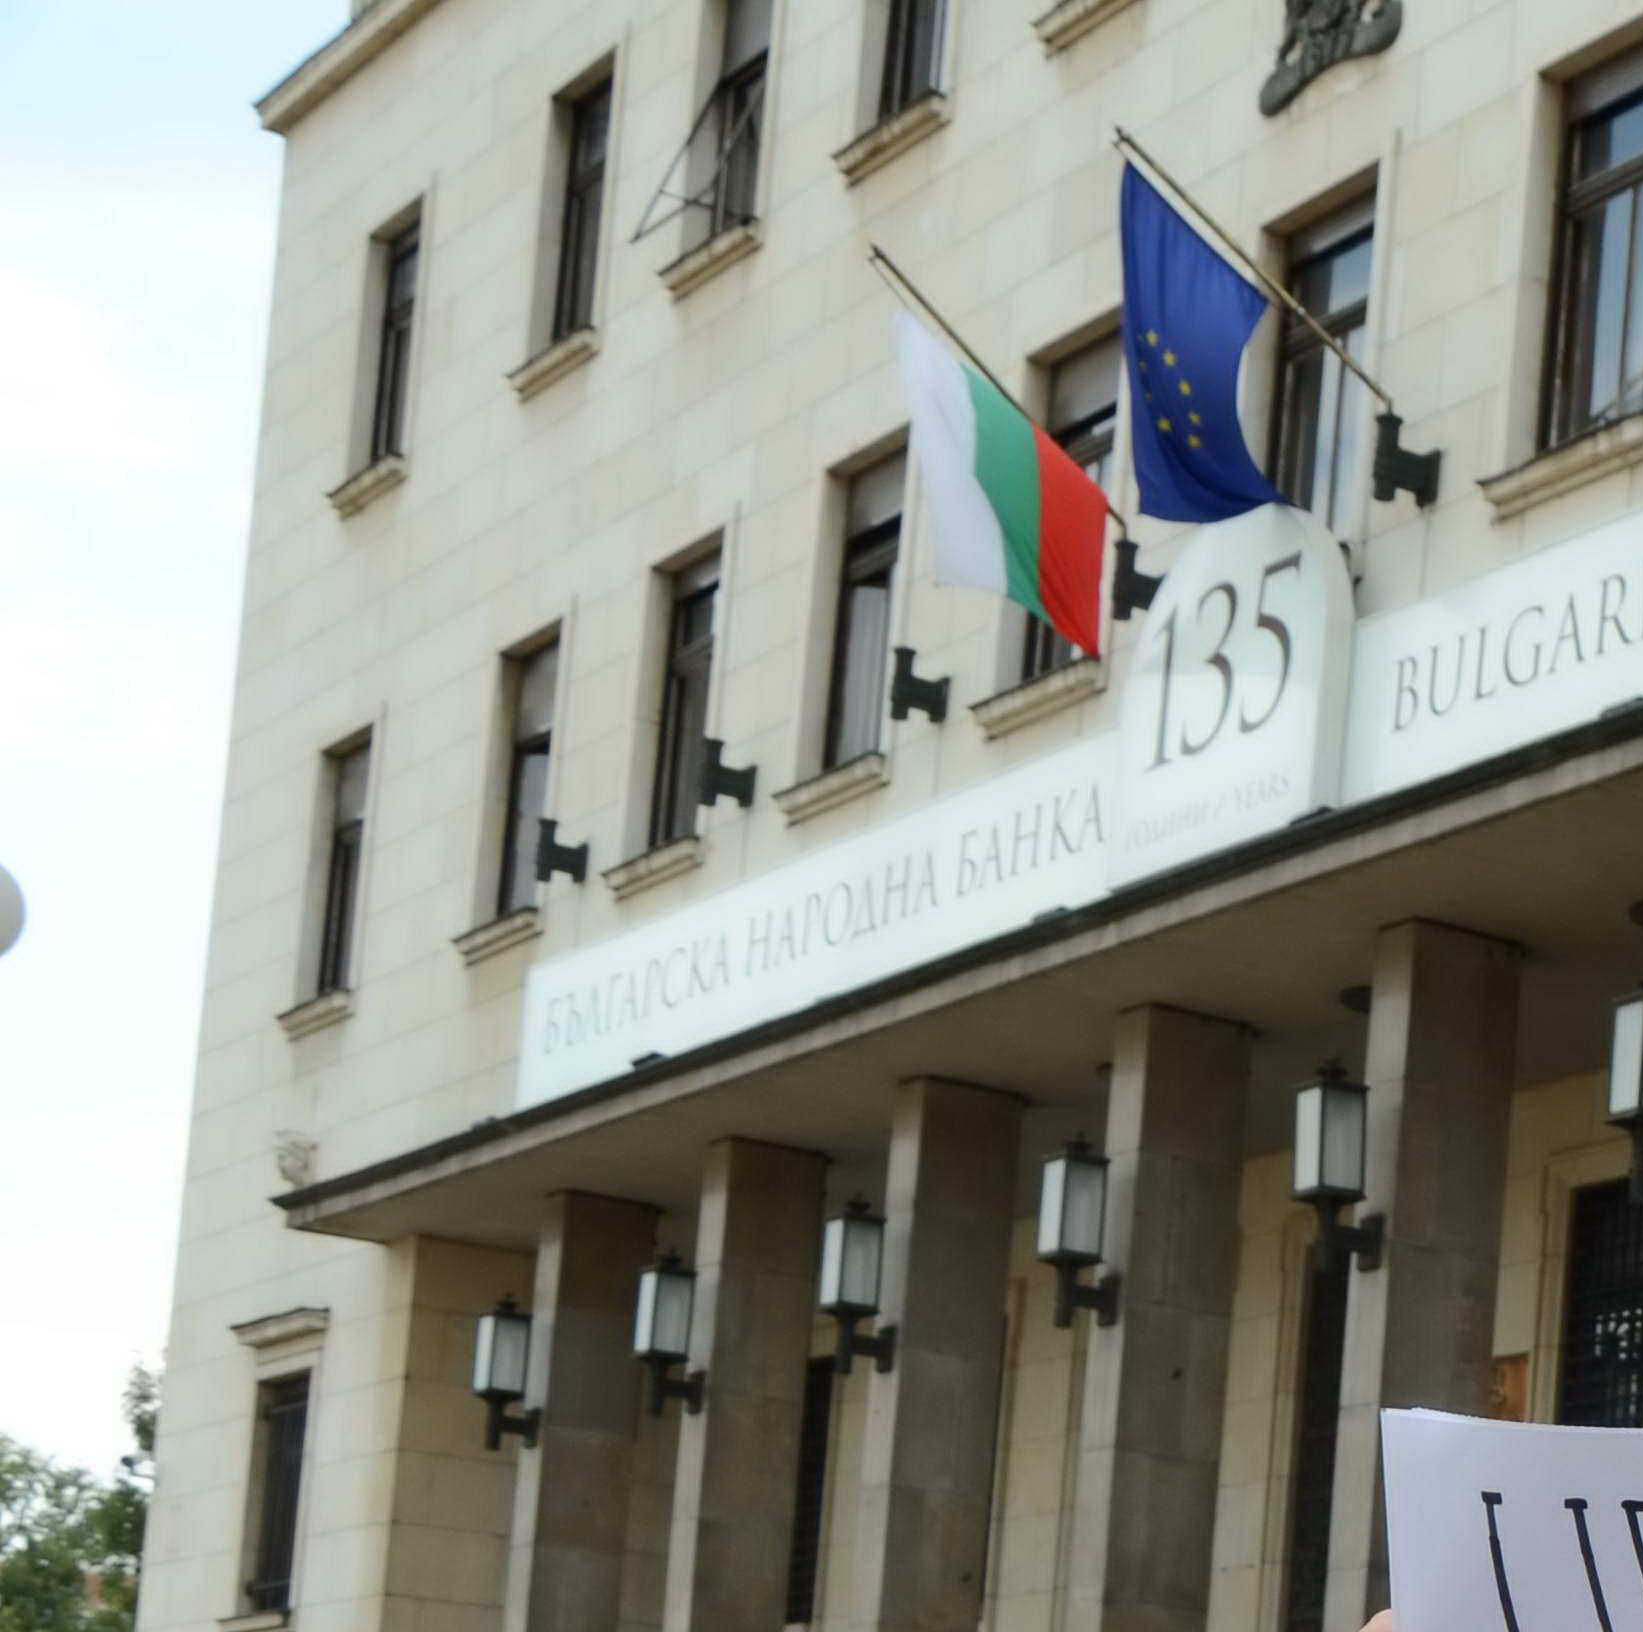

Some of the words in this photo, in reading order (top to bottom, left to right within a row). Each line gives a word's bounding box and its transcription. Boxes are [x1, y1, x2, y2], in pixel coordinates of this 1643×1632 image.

[1144, 551, 1302, 773] 135
[1232, 769, 1292, 813] YEARS
[542, 931, 730, 1055] БЪЛГАРСКА
[745, 848, 938, 977] НАРОДНА
[955, 783, 1107, 898] БАНКА
